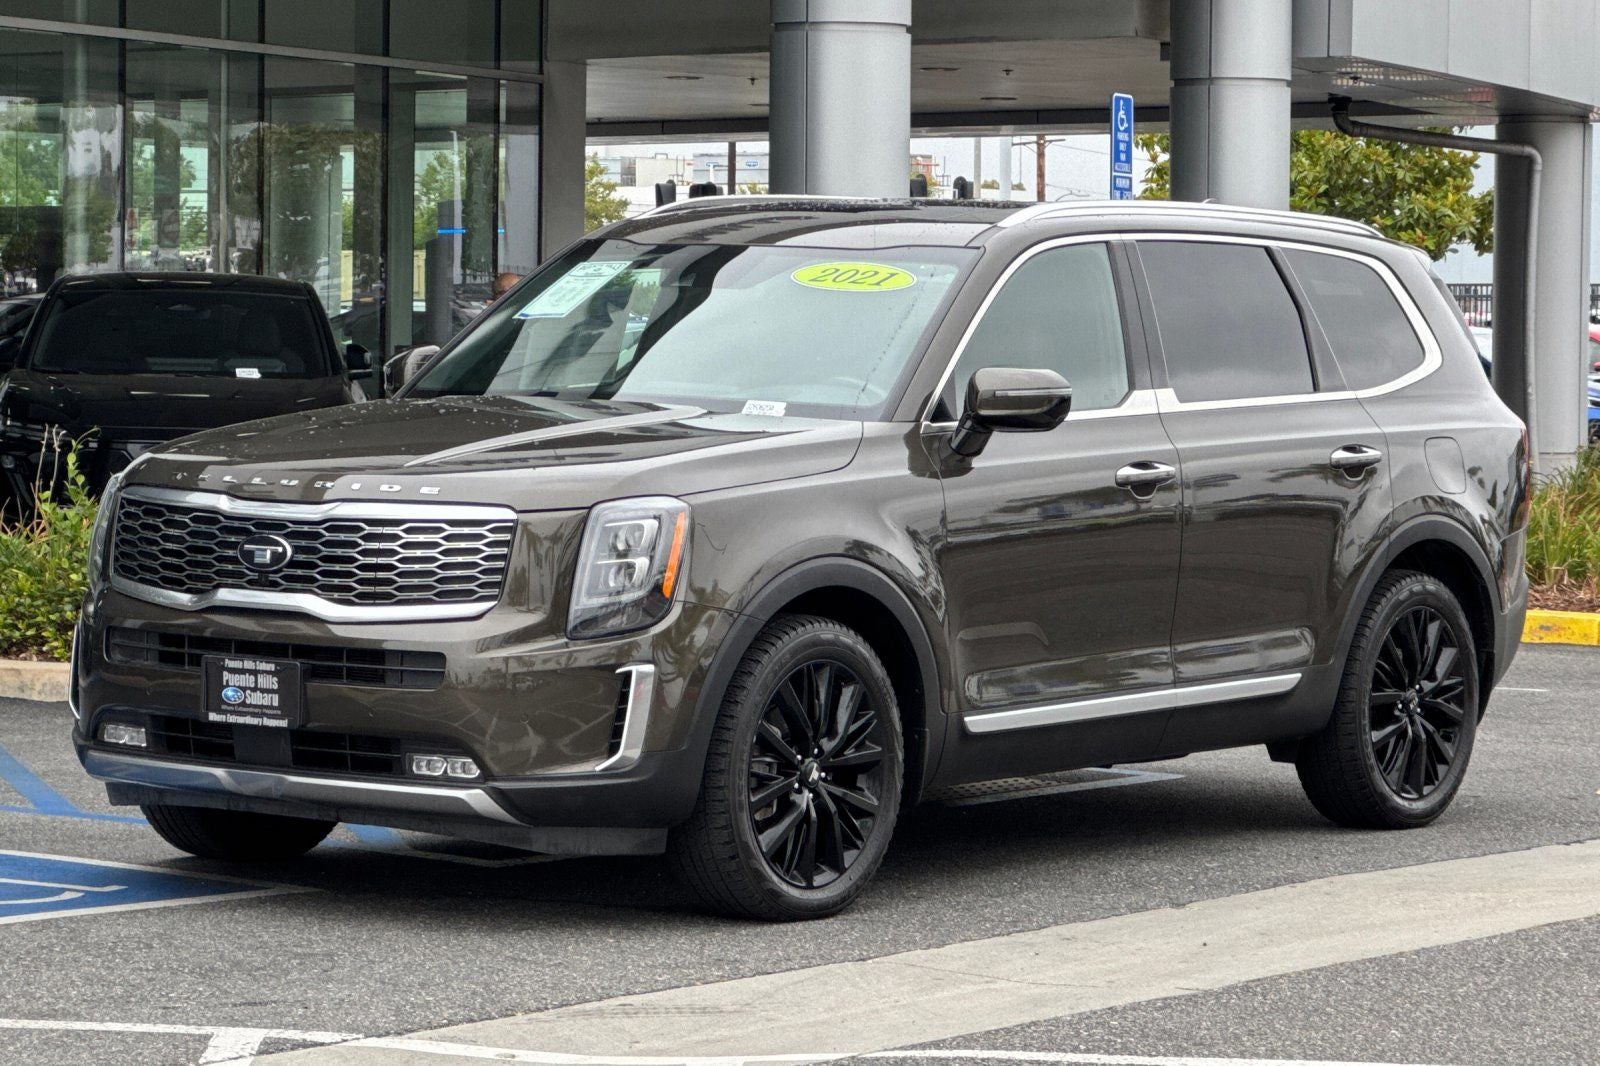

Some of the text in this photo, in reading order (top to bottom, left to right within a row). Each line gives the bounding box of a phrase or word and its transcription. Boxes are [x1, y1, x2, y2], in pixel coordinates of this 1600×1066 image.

[808, 268, 899, 286] 2021
[225, 659, 275, 671] Puente Hills Subaru
[223, 671, 279, 689] Puente Hills
[245, 690, 279, 706] Subaru
[208, 712, 288, 727] Where Extraordinary Happens!
